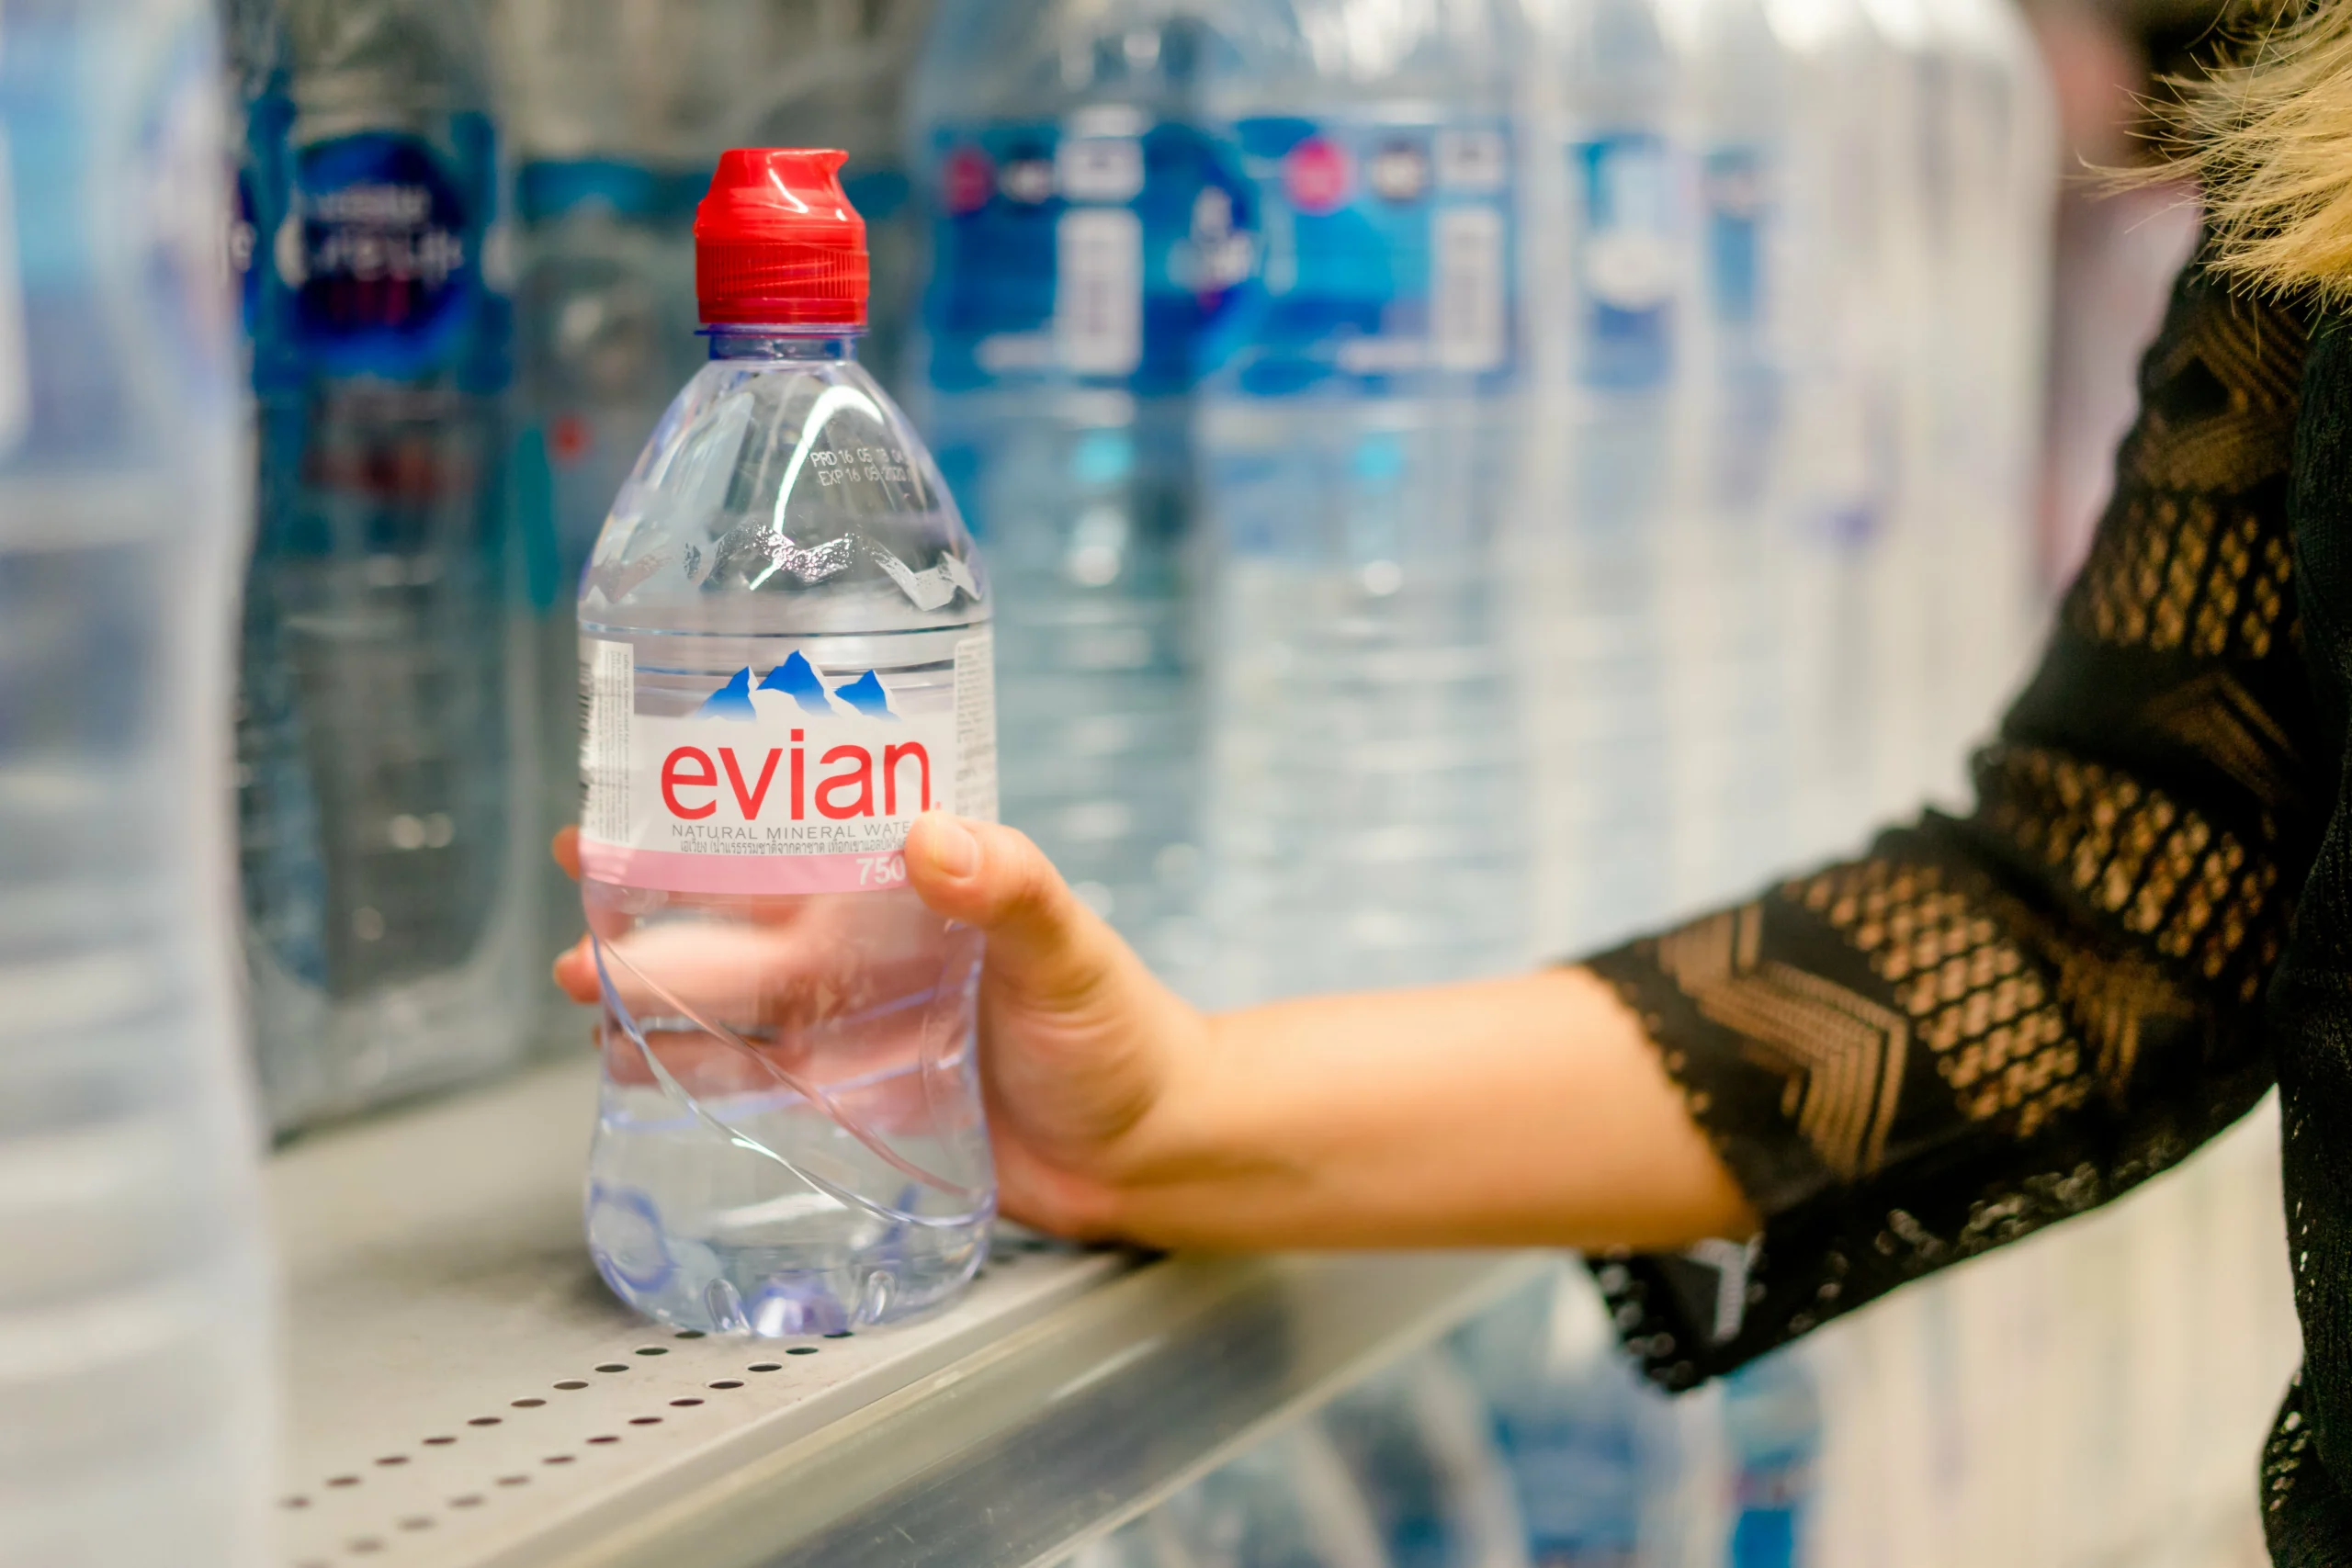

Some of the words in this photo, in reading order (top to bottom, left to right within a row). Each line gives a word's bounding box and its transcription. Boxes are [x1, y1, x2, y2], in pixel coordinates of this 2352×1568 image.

[809, 451, 838, 468] PRD
[838, 449, 854, 464] 16
[818, 469, 843, 487] EXP
[845, 468, 862, 482] 16
[661, 728, 931, 820] evian
[672, 824, 758, 840] NATURAL
[766, 826, 856, 840] MINERAL
[864, 820, 911, 836] WATE
[855, 853, 907, 886] 750
